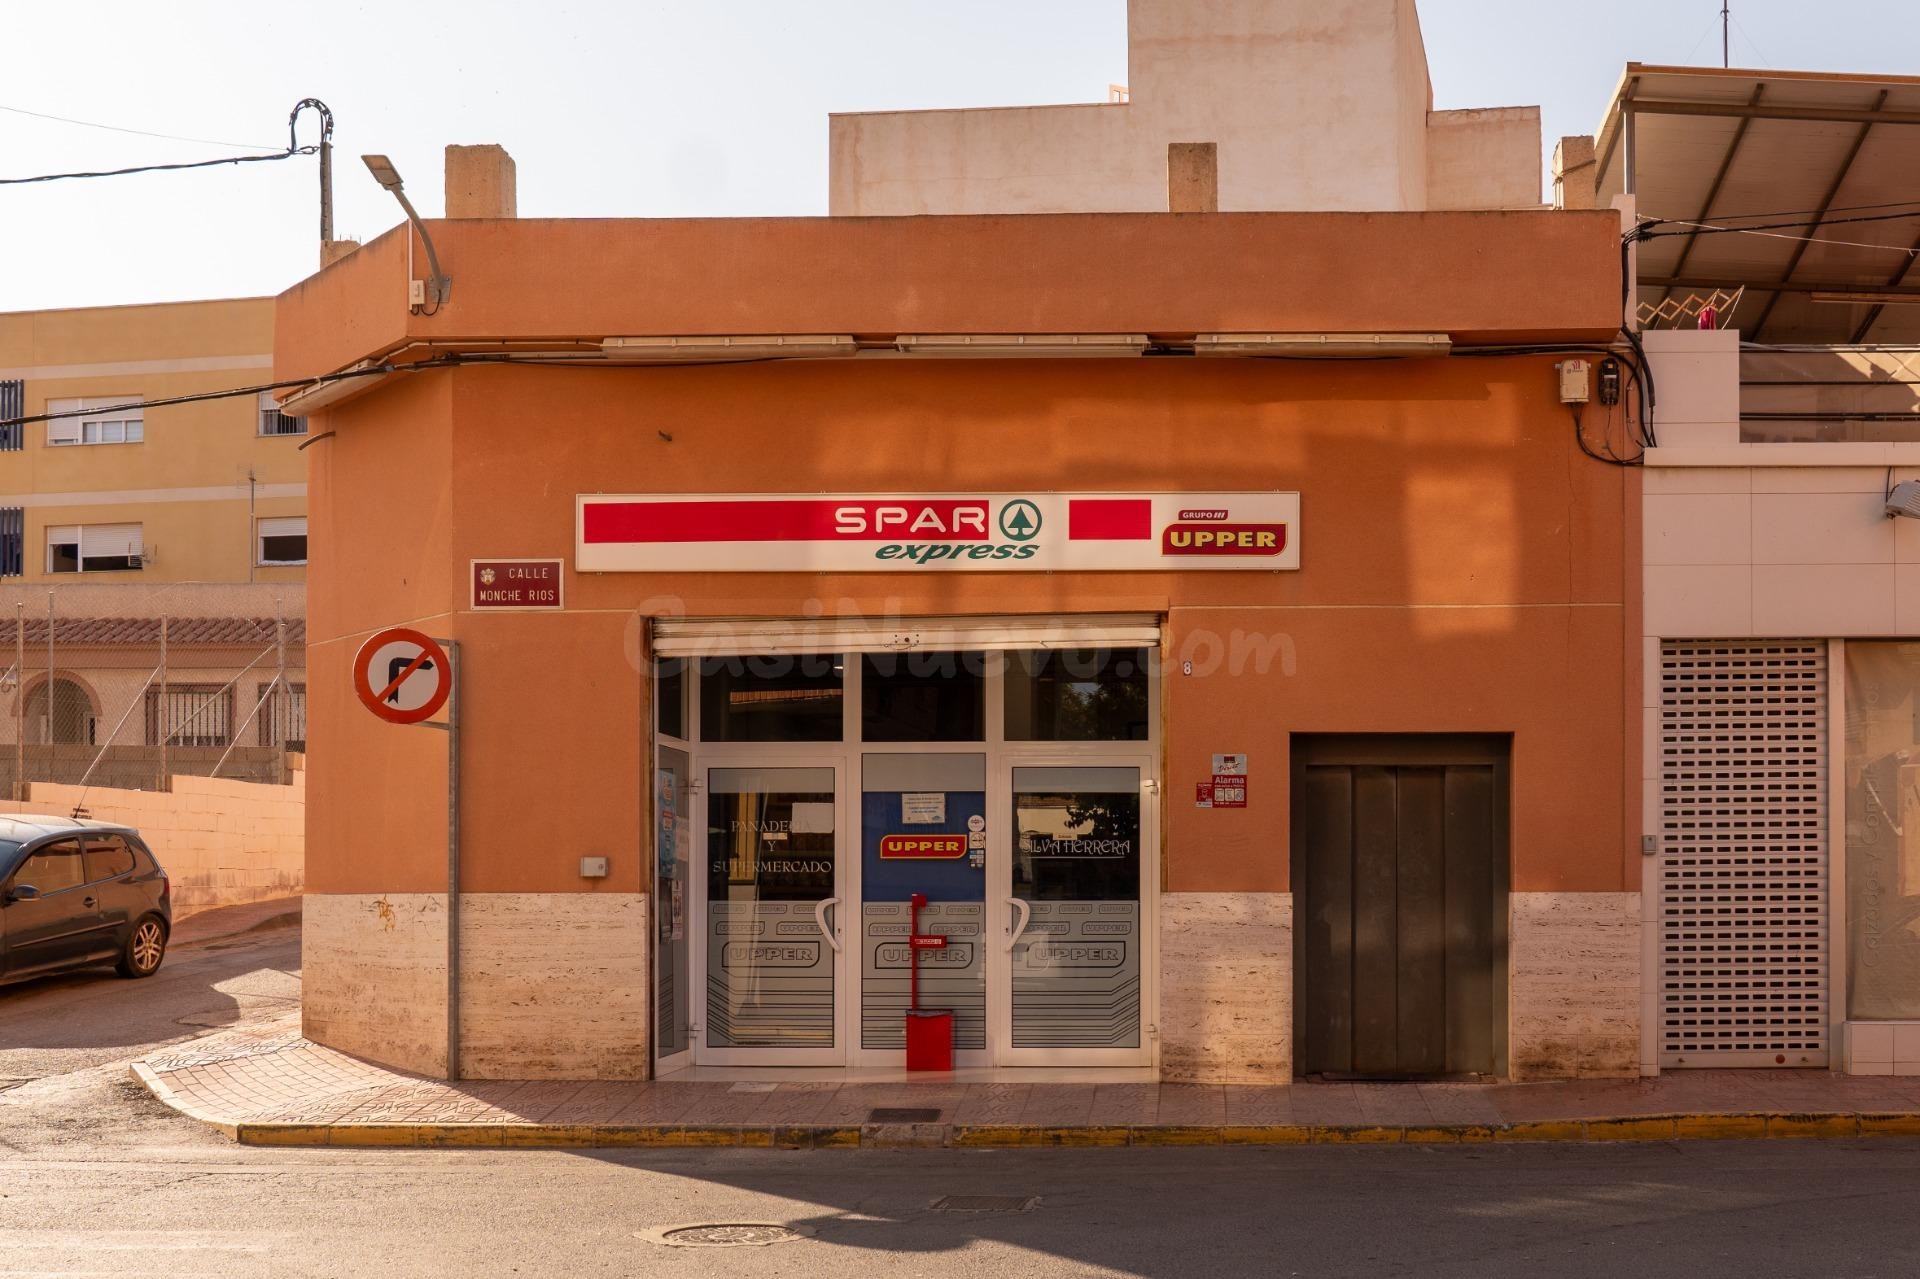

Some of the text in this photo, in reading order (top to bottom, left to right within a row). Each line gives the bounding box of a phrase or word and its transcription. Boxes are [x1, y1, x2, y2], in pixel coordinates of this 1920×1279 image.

[835, 506, 986, 534] SPAR
[1182, 511, 1213, 519] GRUPO
[1170, 531, 1276, 547] UPPER
[875, 544, 1040, 564] express
[509, 568, 549, 579] CALLE
[480, 590, 554, 601] MONCHE RIOS
[1183, 661, 1192, 676] 8
[1214, 776, 1245, 784] Alarma
[767, 840, 776, 852] Y
[888, 841, 960, 852] UPPER
[1021, 838, 1130, 855] SILVA HERRERA
[713, 860, 832, 873] SUPERMERCADO
[730, 948, 813, 961] UPPER
[883, 948, 967, 962] UPPER
[1035, 948, 1119, 961] UPPER
